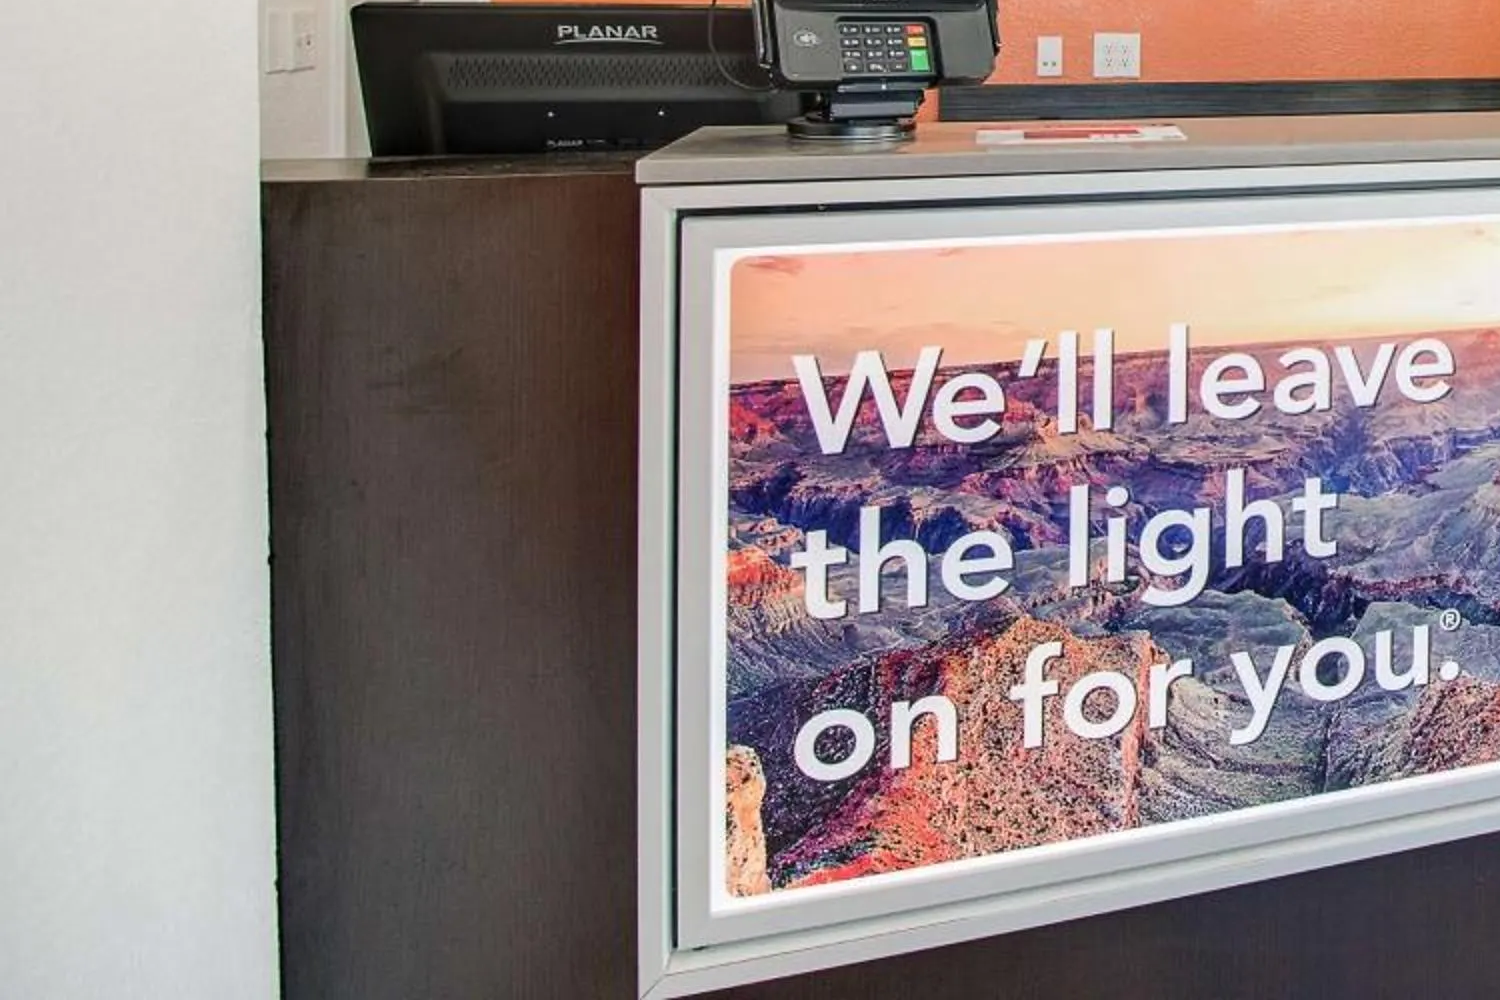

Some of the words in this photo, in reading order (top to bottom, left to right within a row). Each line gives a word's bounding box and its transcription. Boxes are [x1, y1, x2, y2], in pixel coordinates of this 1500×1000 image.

[557, 24, 659, 40] PLANAR
[791, 327, 1115, 456] We'll
[1168, 323, 1456, 424] leave
[790, 505, 1015, 620] the
[1068, 467, 1339, 606] light
[793, 694, 959, 782] on
[1009, 641, 1193, 749] for
